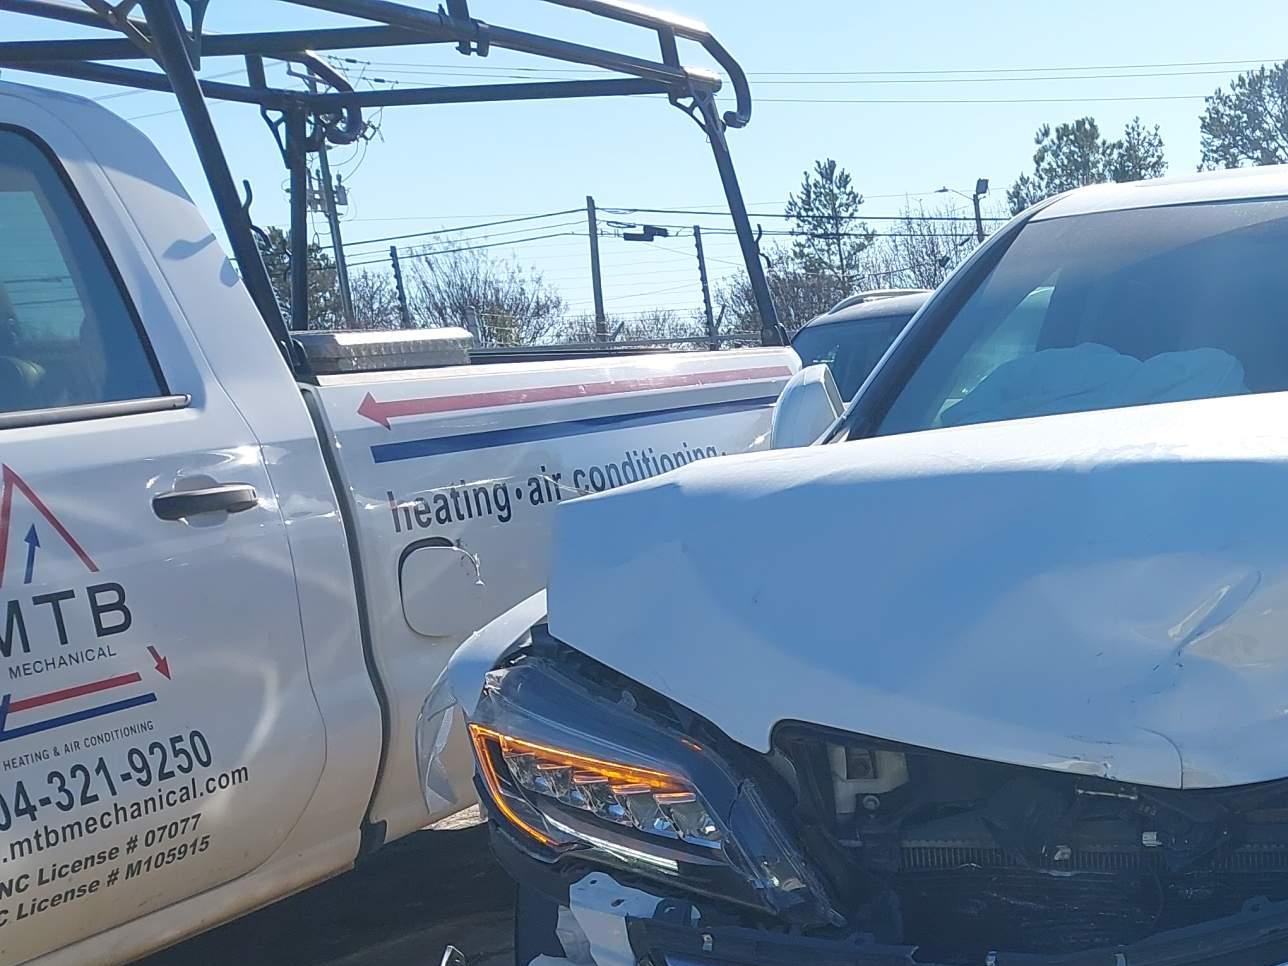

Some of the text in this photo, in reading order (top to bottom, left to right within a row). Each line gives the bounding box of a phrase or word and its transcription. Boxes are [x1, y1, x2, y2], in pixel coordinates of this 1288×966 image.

[0, 582, 132, 658] MTB
[9, 645, 117, 680] MECHANICAL
[3, 748, 50, 771] HEATING
[64, 741, 81, 755] AIR
[84, 720, 154, 747] CONDITIONING
[16, 877, 100, 921] License
[106, 870, 120, 888] #
[125, 834, 211, 881] M105915
[38, 846, 119, 886] License
[126, 836, 138, 853] #
[144, 813, 202, 849] 07077
